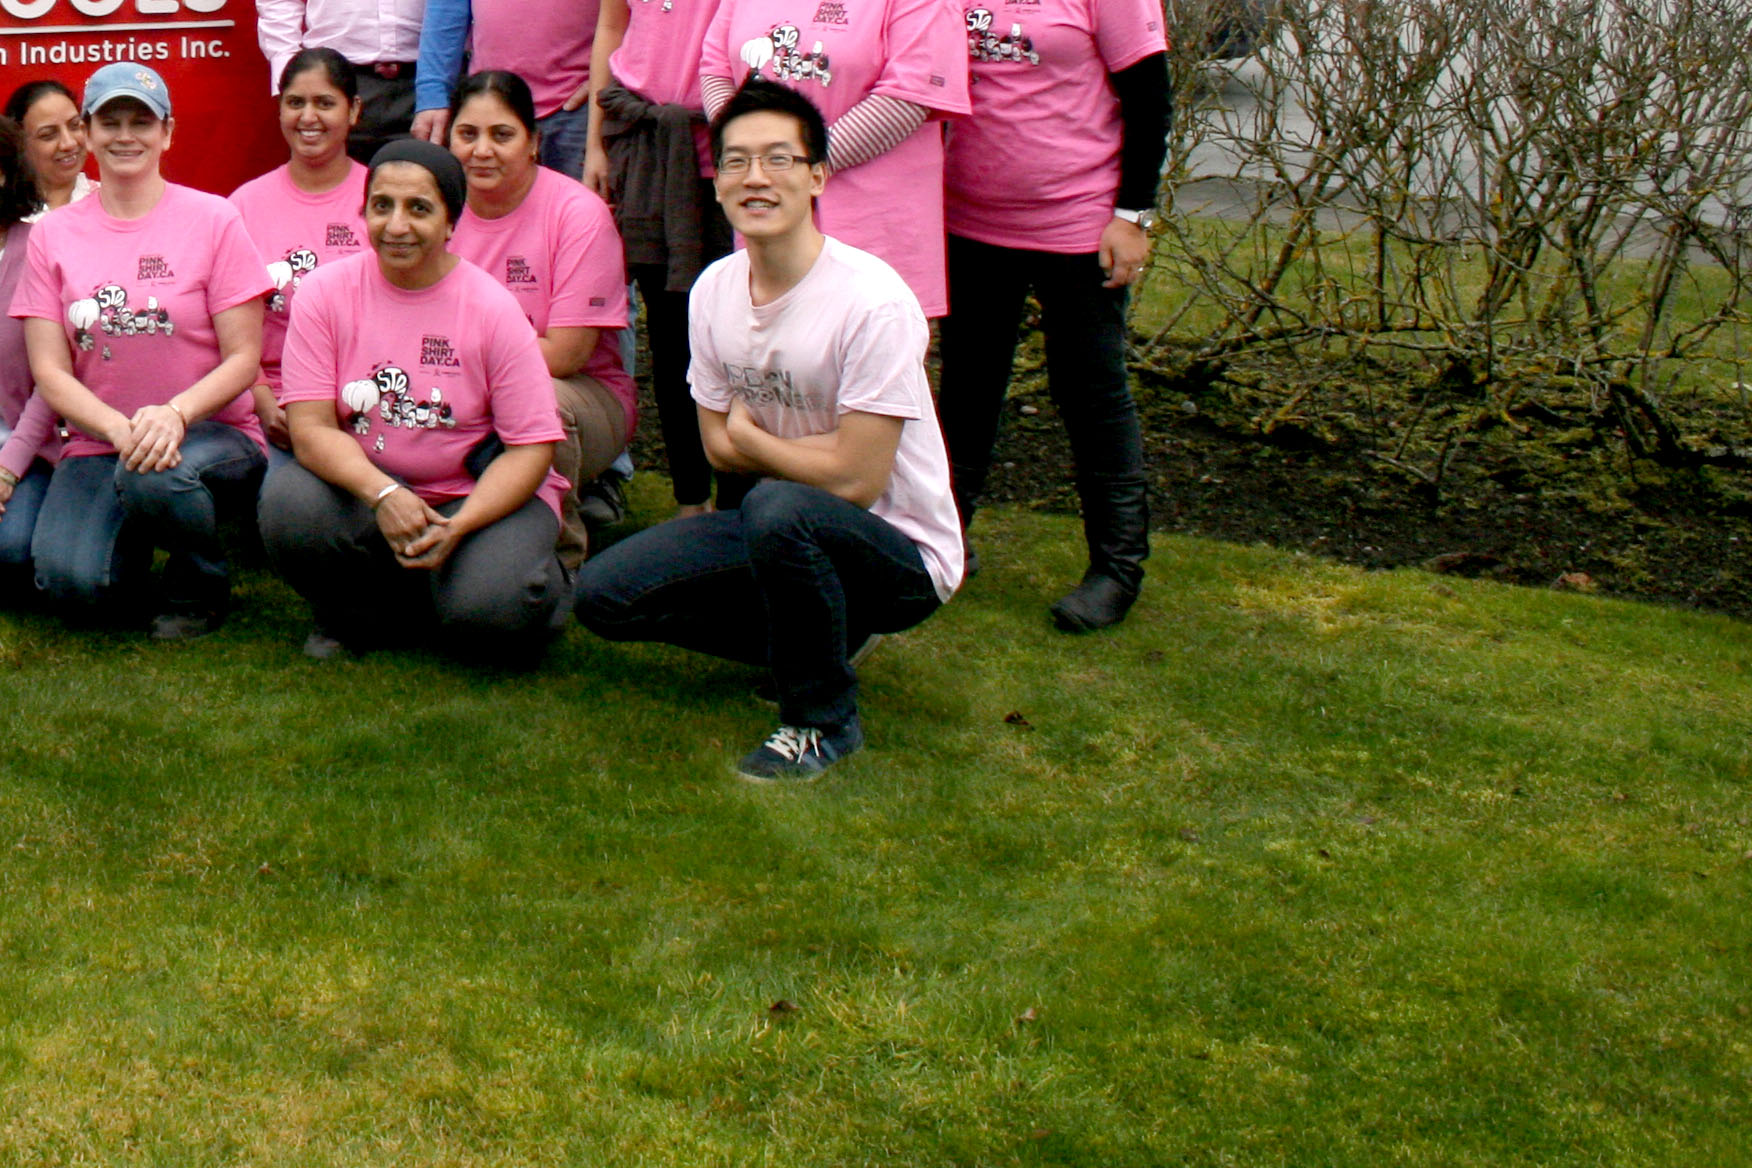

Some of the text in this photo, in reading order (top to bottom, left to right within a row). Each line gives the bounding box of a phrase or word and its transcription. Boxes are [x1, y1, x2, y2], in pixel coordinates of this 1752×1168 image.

[20, 36, 169, 66] Industries
[180, 36, 231, 59] Inc.
[325, 239, 361, 247] DAY.CA
[138, 256, 164, 265] PINK
[138, 263, 168, 272] SHIRT
[137, 270, 175, 280] DAY.CA
[422, 337, 450, 348] PINK
[421, 347, 455, 357] SHIRT
[420, 356, 460, 367] DAY.CA
